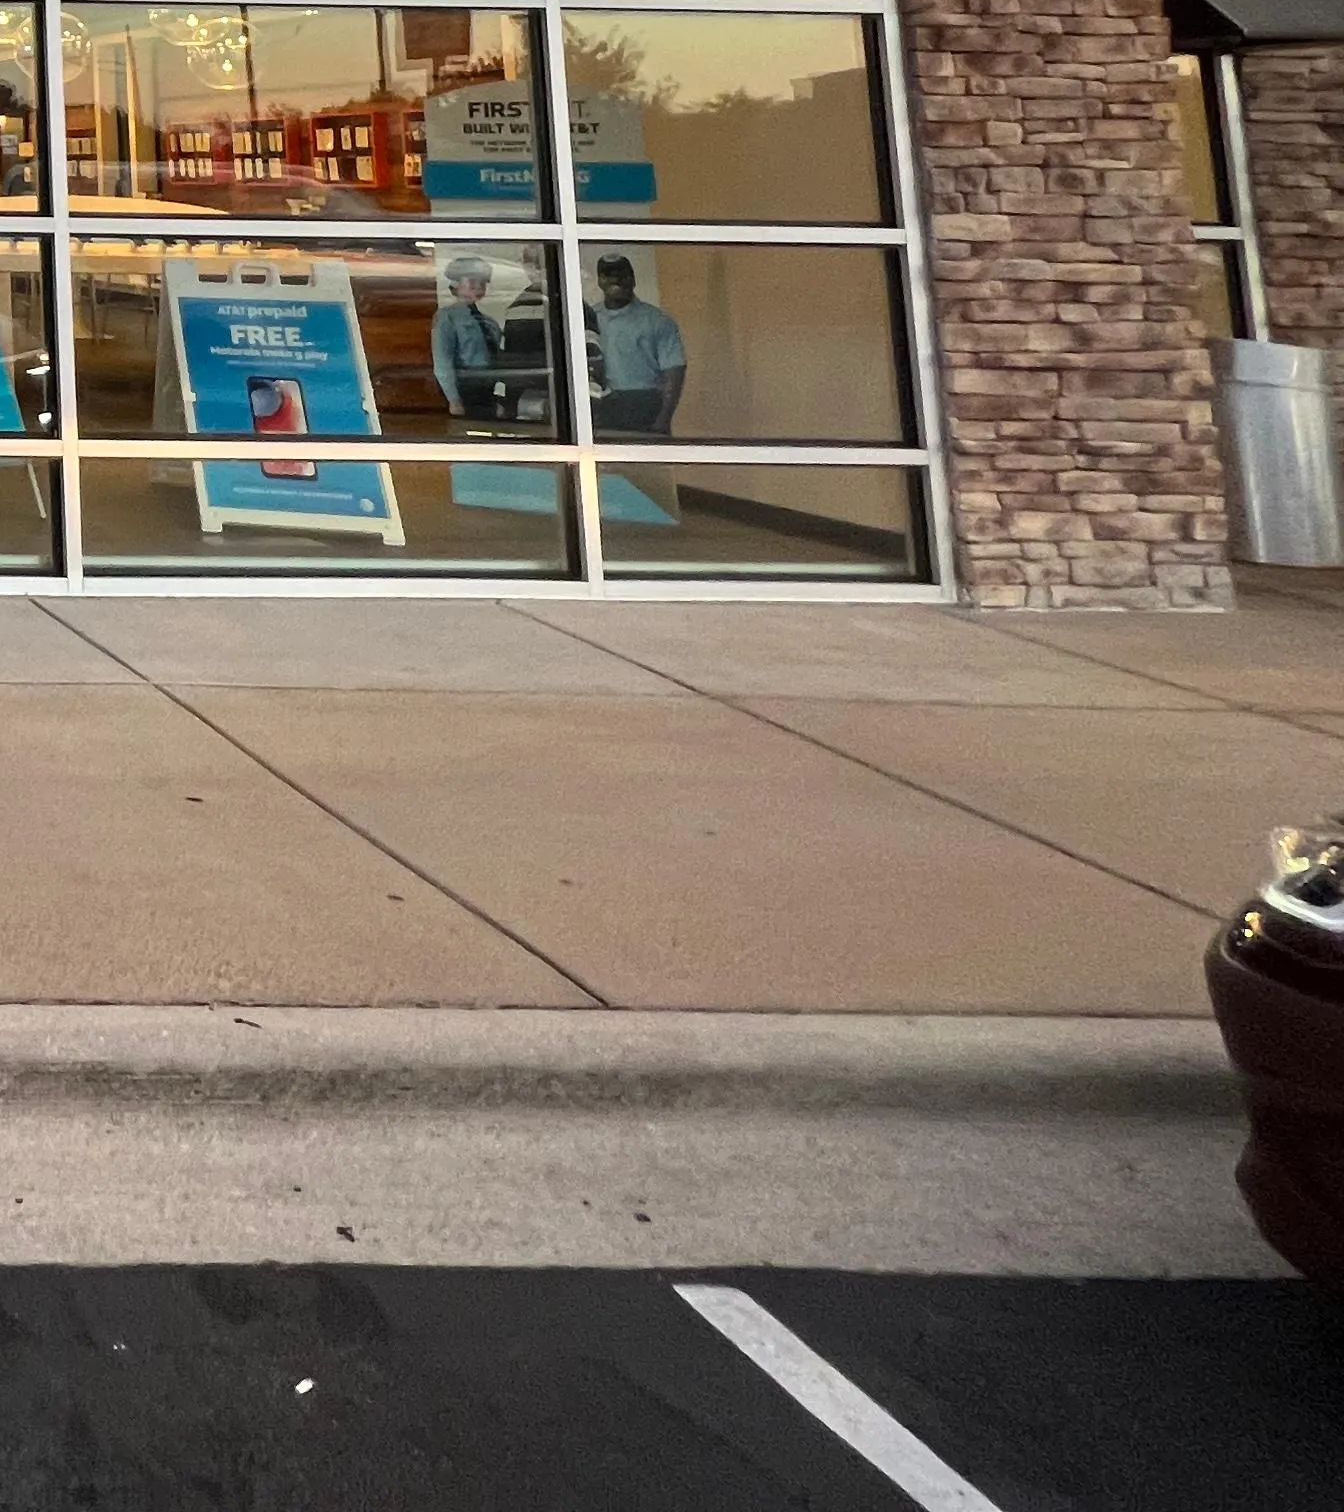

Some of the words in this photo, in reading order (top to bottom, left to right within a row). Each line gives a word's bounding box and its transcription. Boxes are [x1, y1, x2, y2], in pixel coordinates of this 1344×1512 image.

[463, 123, 503, 135] BUILT
[569, 122, 600, 134] T&T
[247, 305, 308, 320] prepaid
